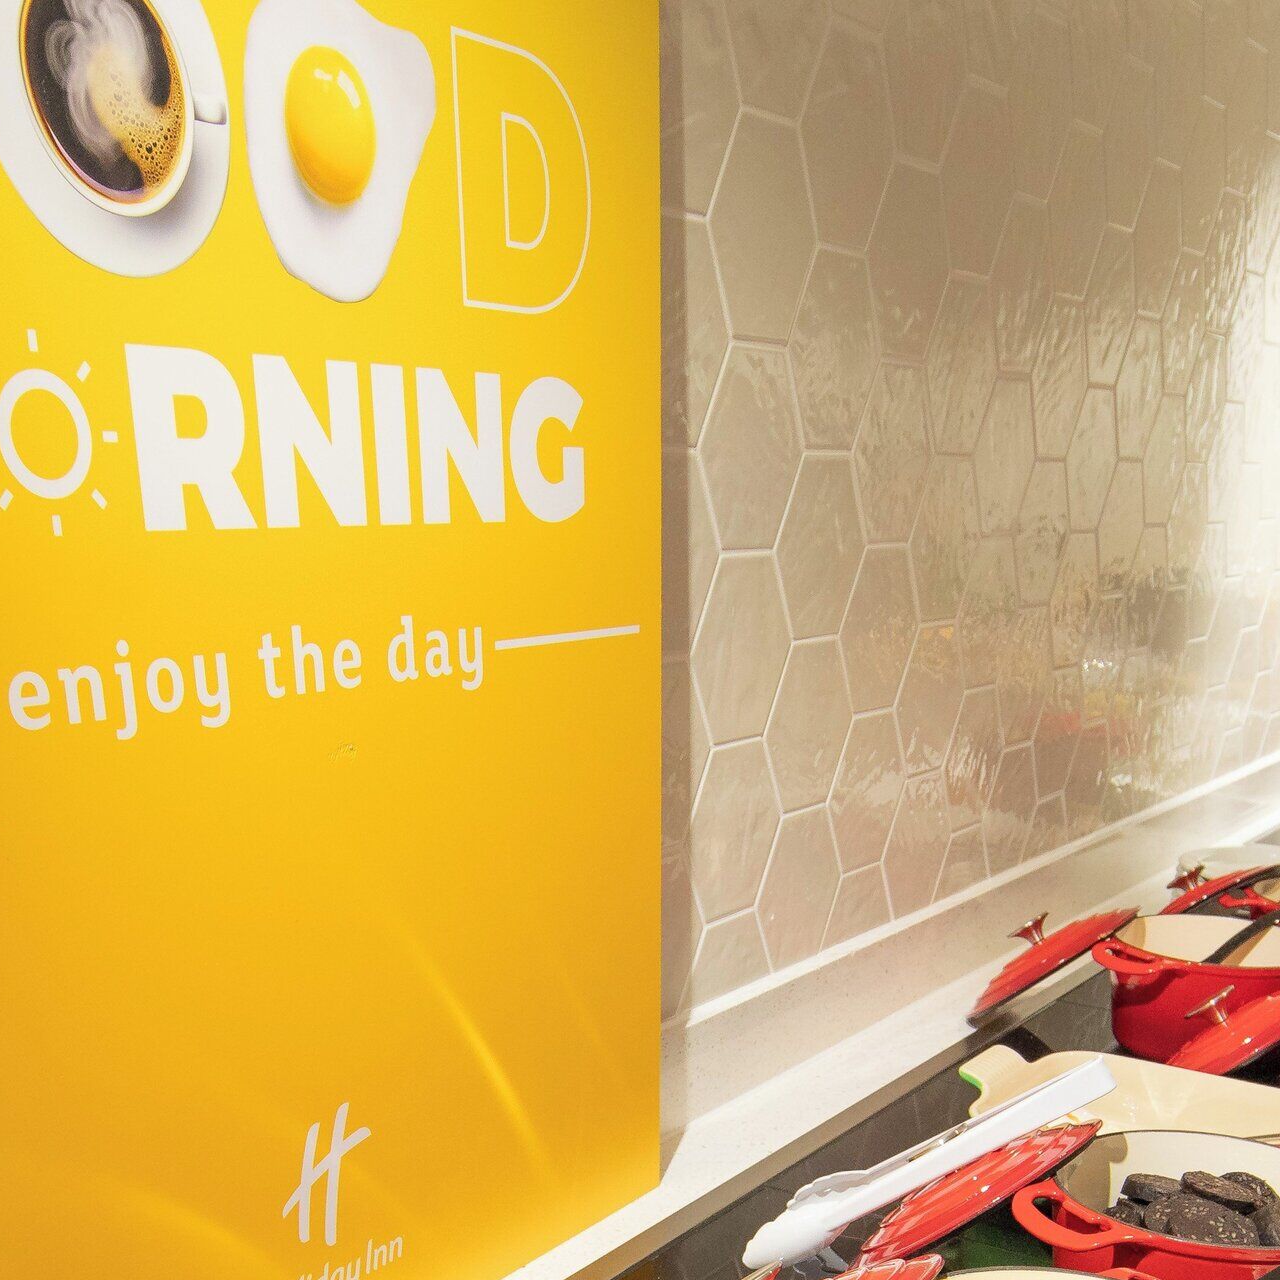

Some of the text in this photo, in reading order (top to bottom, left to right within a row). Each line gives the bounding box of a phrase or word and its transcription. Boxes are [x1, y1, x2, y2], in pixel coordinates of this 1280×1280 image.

[7, 615, 485, 741] enjoy the day
[365, 1236, 404, 1275] Inn
